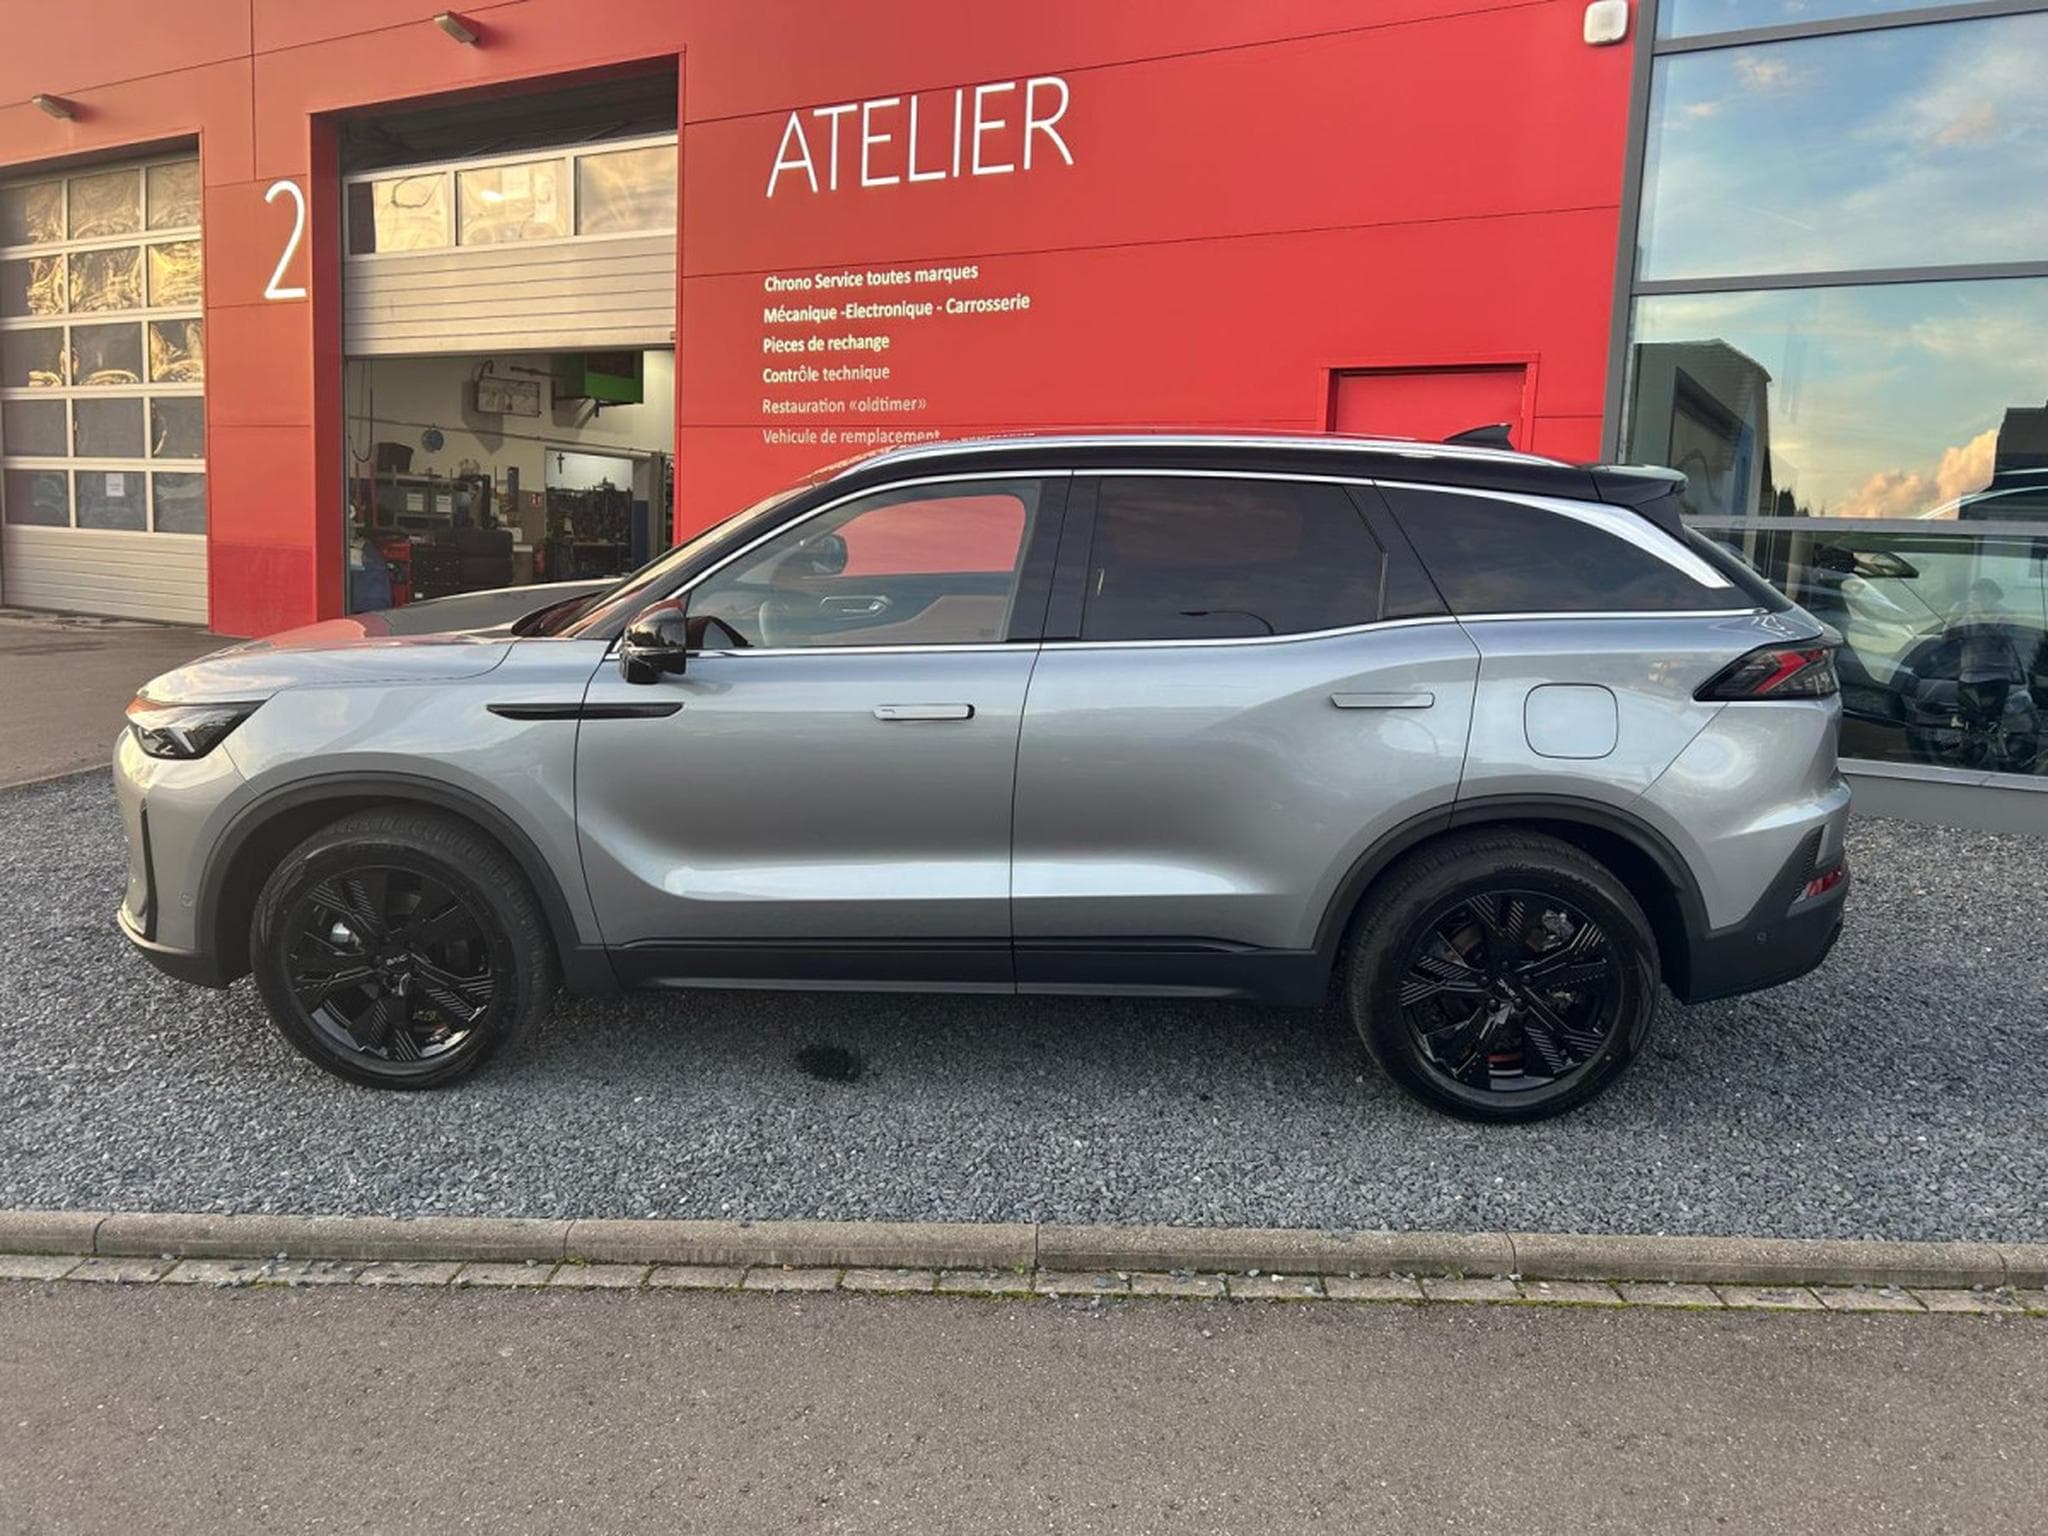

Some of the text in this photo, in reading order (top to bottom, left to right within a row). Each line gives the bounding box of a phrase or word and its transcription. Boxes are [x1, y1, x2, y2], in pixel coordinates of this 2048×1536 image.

[766, 76, 1074, 198] ATELIER
[264, 180, 307, 299] 2
[764, 264, 979, 292] Chrono Service toutes marques
[763, 306, 837, 324] Mécanique
[945, 293, 1031, 314] Carrosserie
[807, 334, 825, 351] de
[827, 333, 890, 352] rechange
[762, 363, 890, 383] Contrôle technique
[762, 397, 845, 414] Restauration
[820, 427, 837, 444] de
